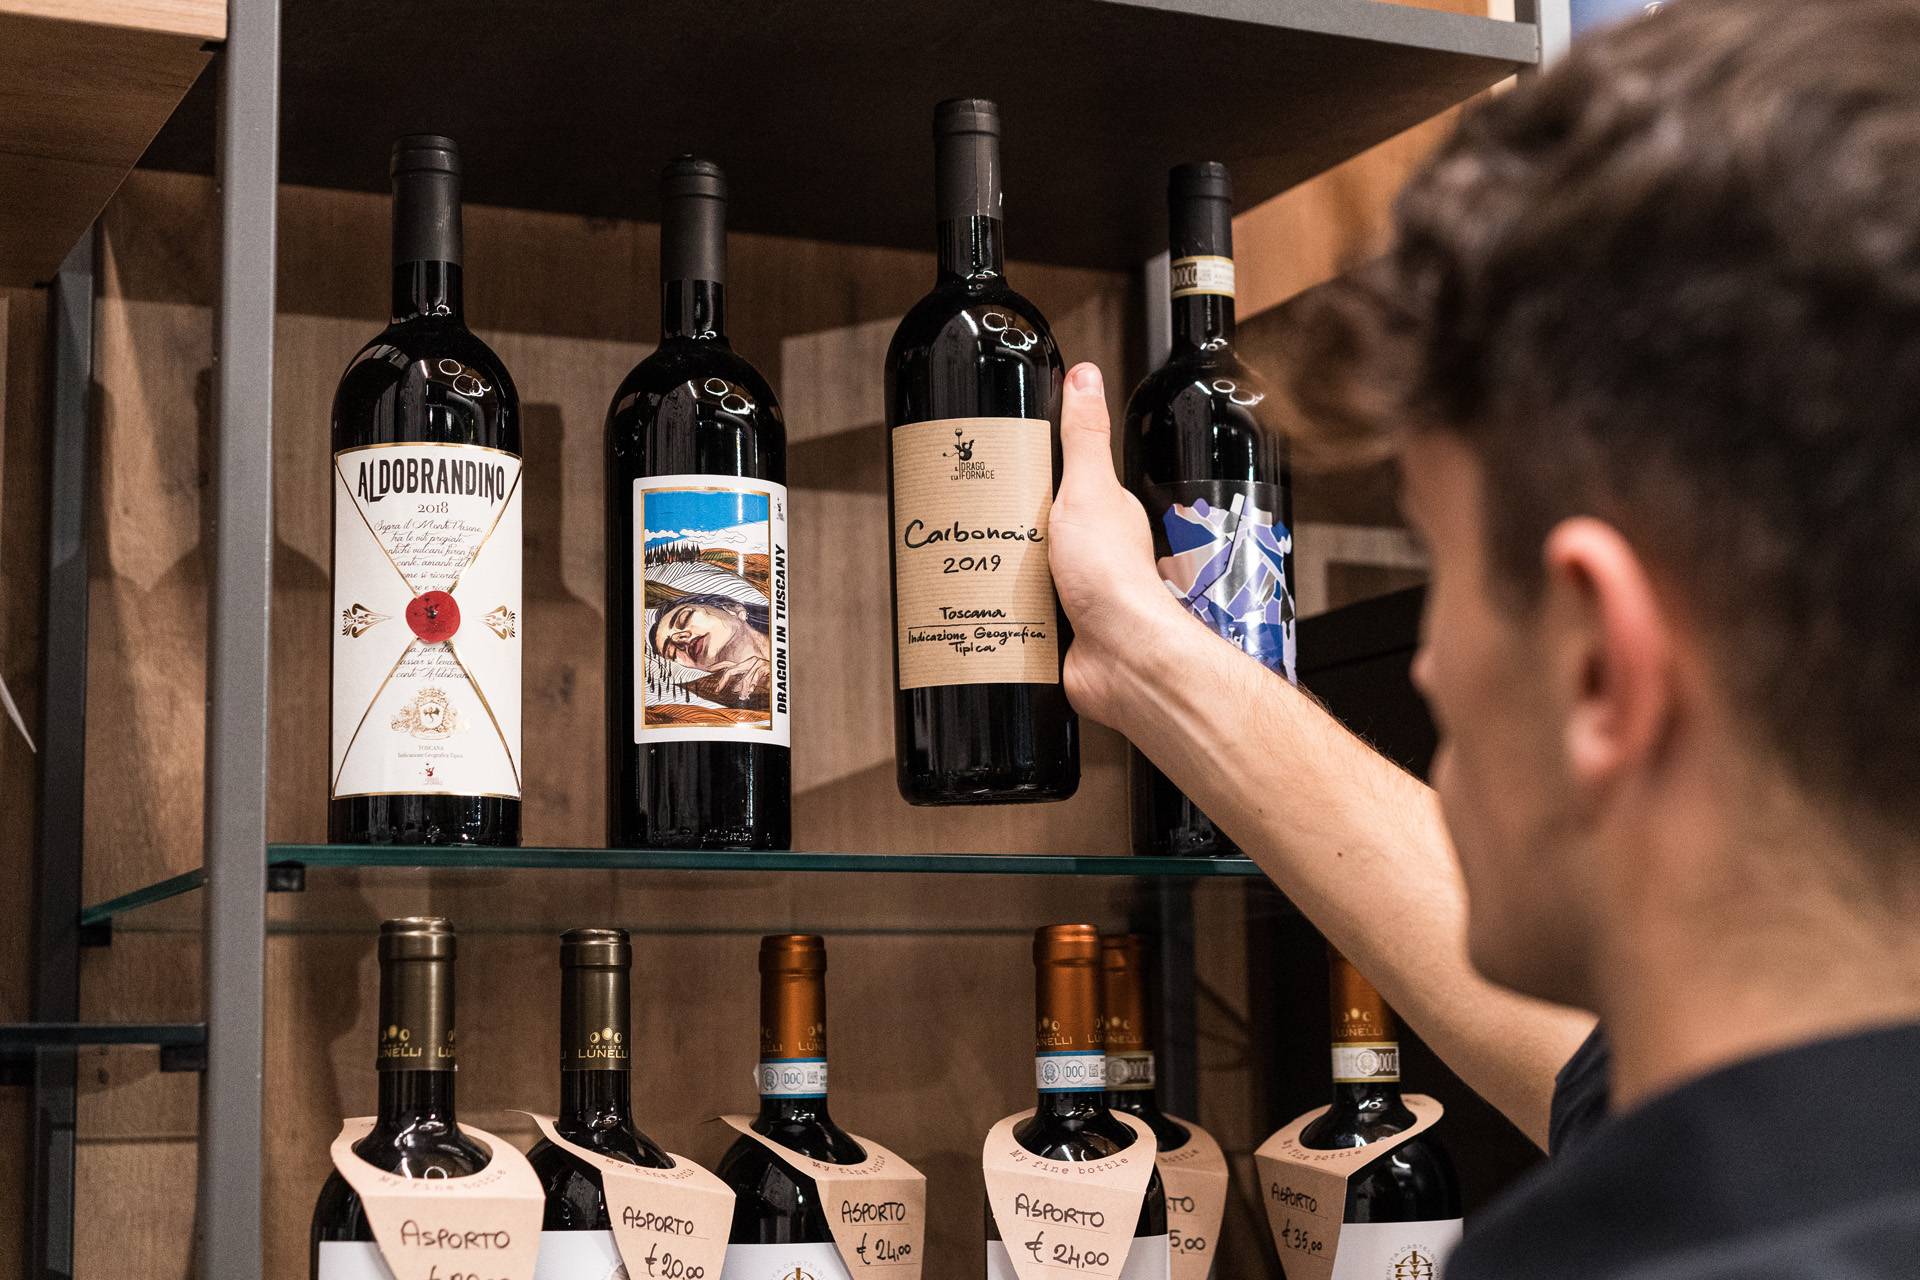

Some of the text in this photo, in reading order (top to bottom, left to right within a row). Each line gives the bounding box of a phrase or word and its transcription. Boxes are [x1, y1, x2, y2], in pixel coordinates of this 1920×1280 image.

[960, 461, 986, 471] DRAGO
[961, 470, 995, 480] FORNACE
[358, 457, 506, 507] ALDOBRANDINO
[417, 502, 449, 514] 2018
[374, 519, 401, 534] Sopra
[904, 519, 1044, 548] Carbonaie
[943, 554, 1002, 574] 2019
[939, 606, 1006, 620] Toscana
[775, 544, 788, 714] DRAGON IN TUSCANY
[908, 626, 1046, 645] Indicazione Geografica
[949, 642, 996, 657] Tipica
[424, 667, 469, 679] Aldobran
[784, 1072, 801, 1084] DOC
[1065, 1065, 1083, 1078] DOC
[1009, 1149, 1129, 1175] My fine bottle
[1313, 1150, 1362, 1161] bottle
[1271, 1182, 1318, 1213] ASPORTO
[623, 1206, 694, 1235] ASPORTO
[841, 1200, 906, 1223] ASPORTO
[1015, 1193, 1105, 1228] ASPORTO
[401, 1219, 511, 1249] ASPORTO
[1294, 1228, 1323, 1255] 35,00
[875, 1239, 912, 1262] 24,00
[1025, 1230, 1109, 1269] € 24,00
[662, 1253, 704, 1280] 20,00
